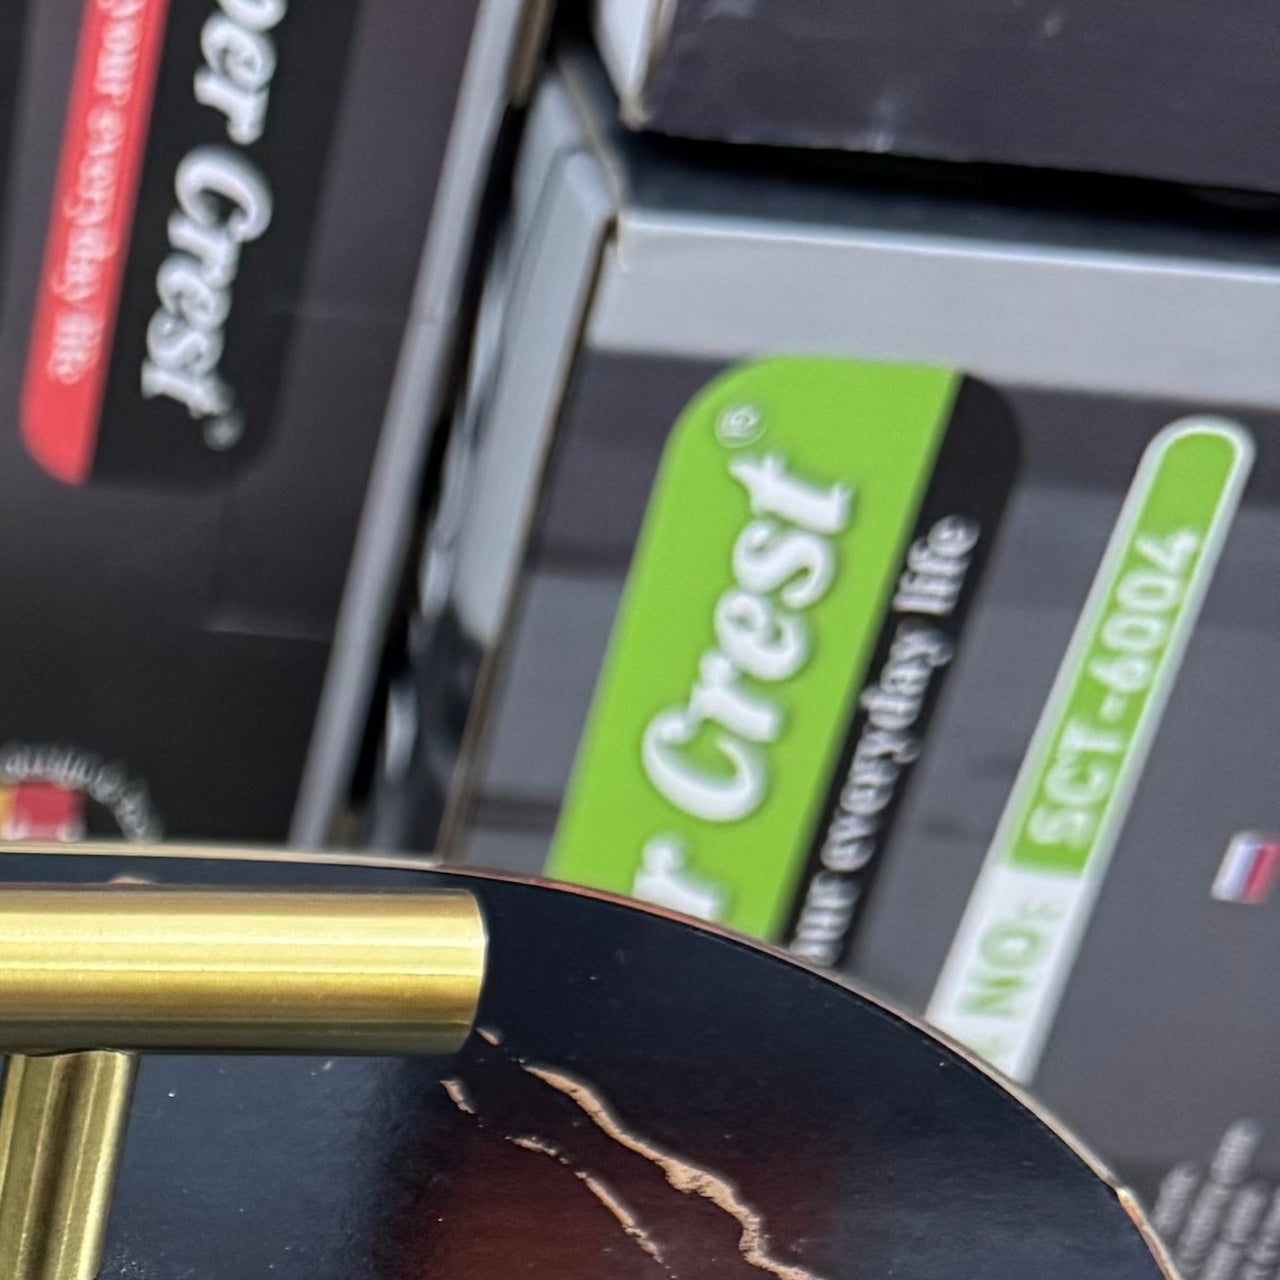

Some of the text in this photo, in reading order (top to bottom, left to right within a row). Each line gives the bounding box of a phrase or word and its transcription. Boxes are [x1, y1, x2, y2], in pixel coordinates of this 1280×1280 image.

[821, 618, 954, 872] everyday
[893, 513, 981, 616] life
[1027, 527, 1203, 850] SCT-6004
